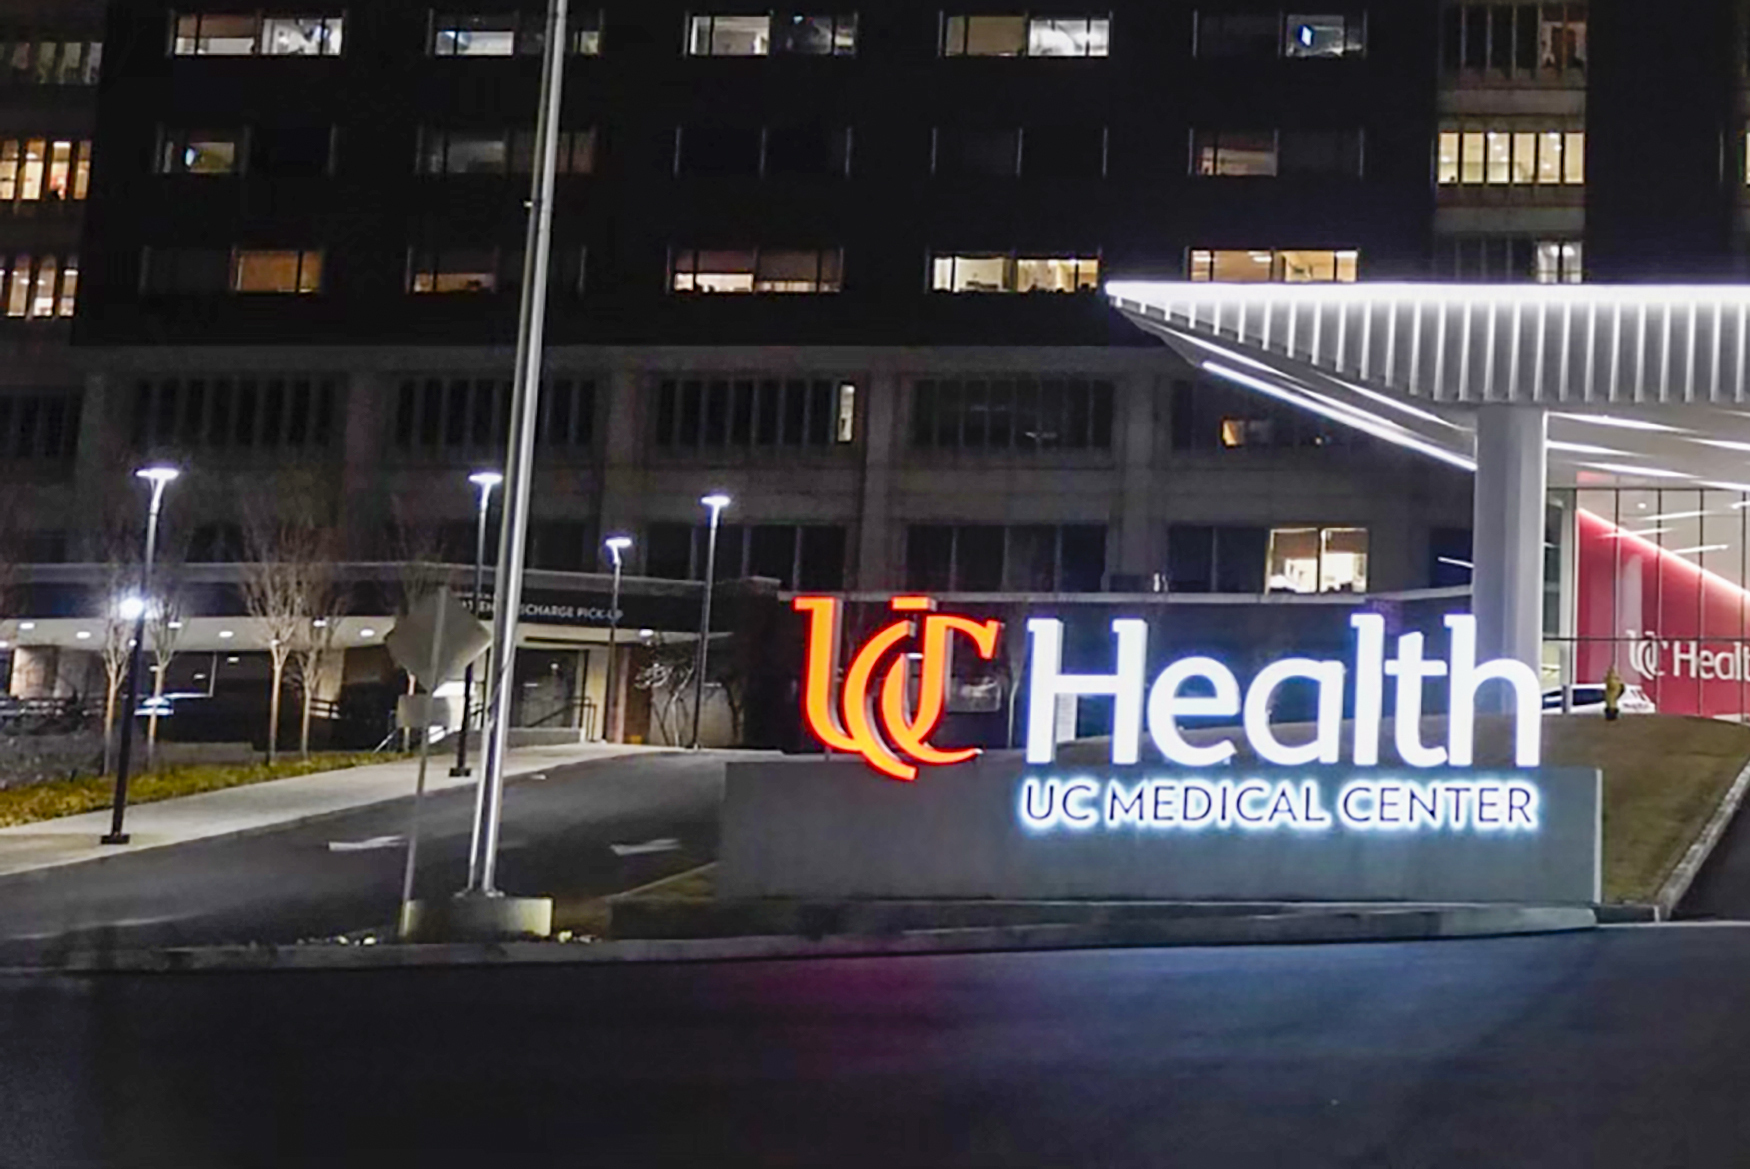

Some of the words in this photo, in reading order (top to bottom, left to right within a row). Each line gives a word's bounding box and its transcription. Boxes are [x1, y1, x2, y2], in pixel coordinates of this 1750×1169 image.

[1027, 614, 1542, 768] Health
[1025, 786, 1093, 822] UC
[1109, 787, 1331, 824] MEDICAL
[1341, 787, 1534, 825] CENTER
